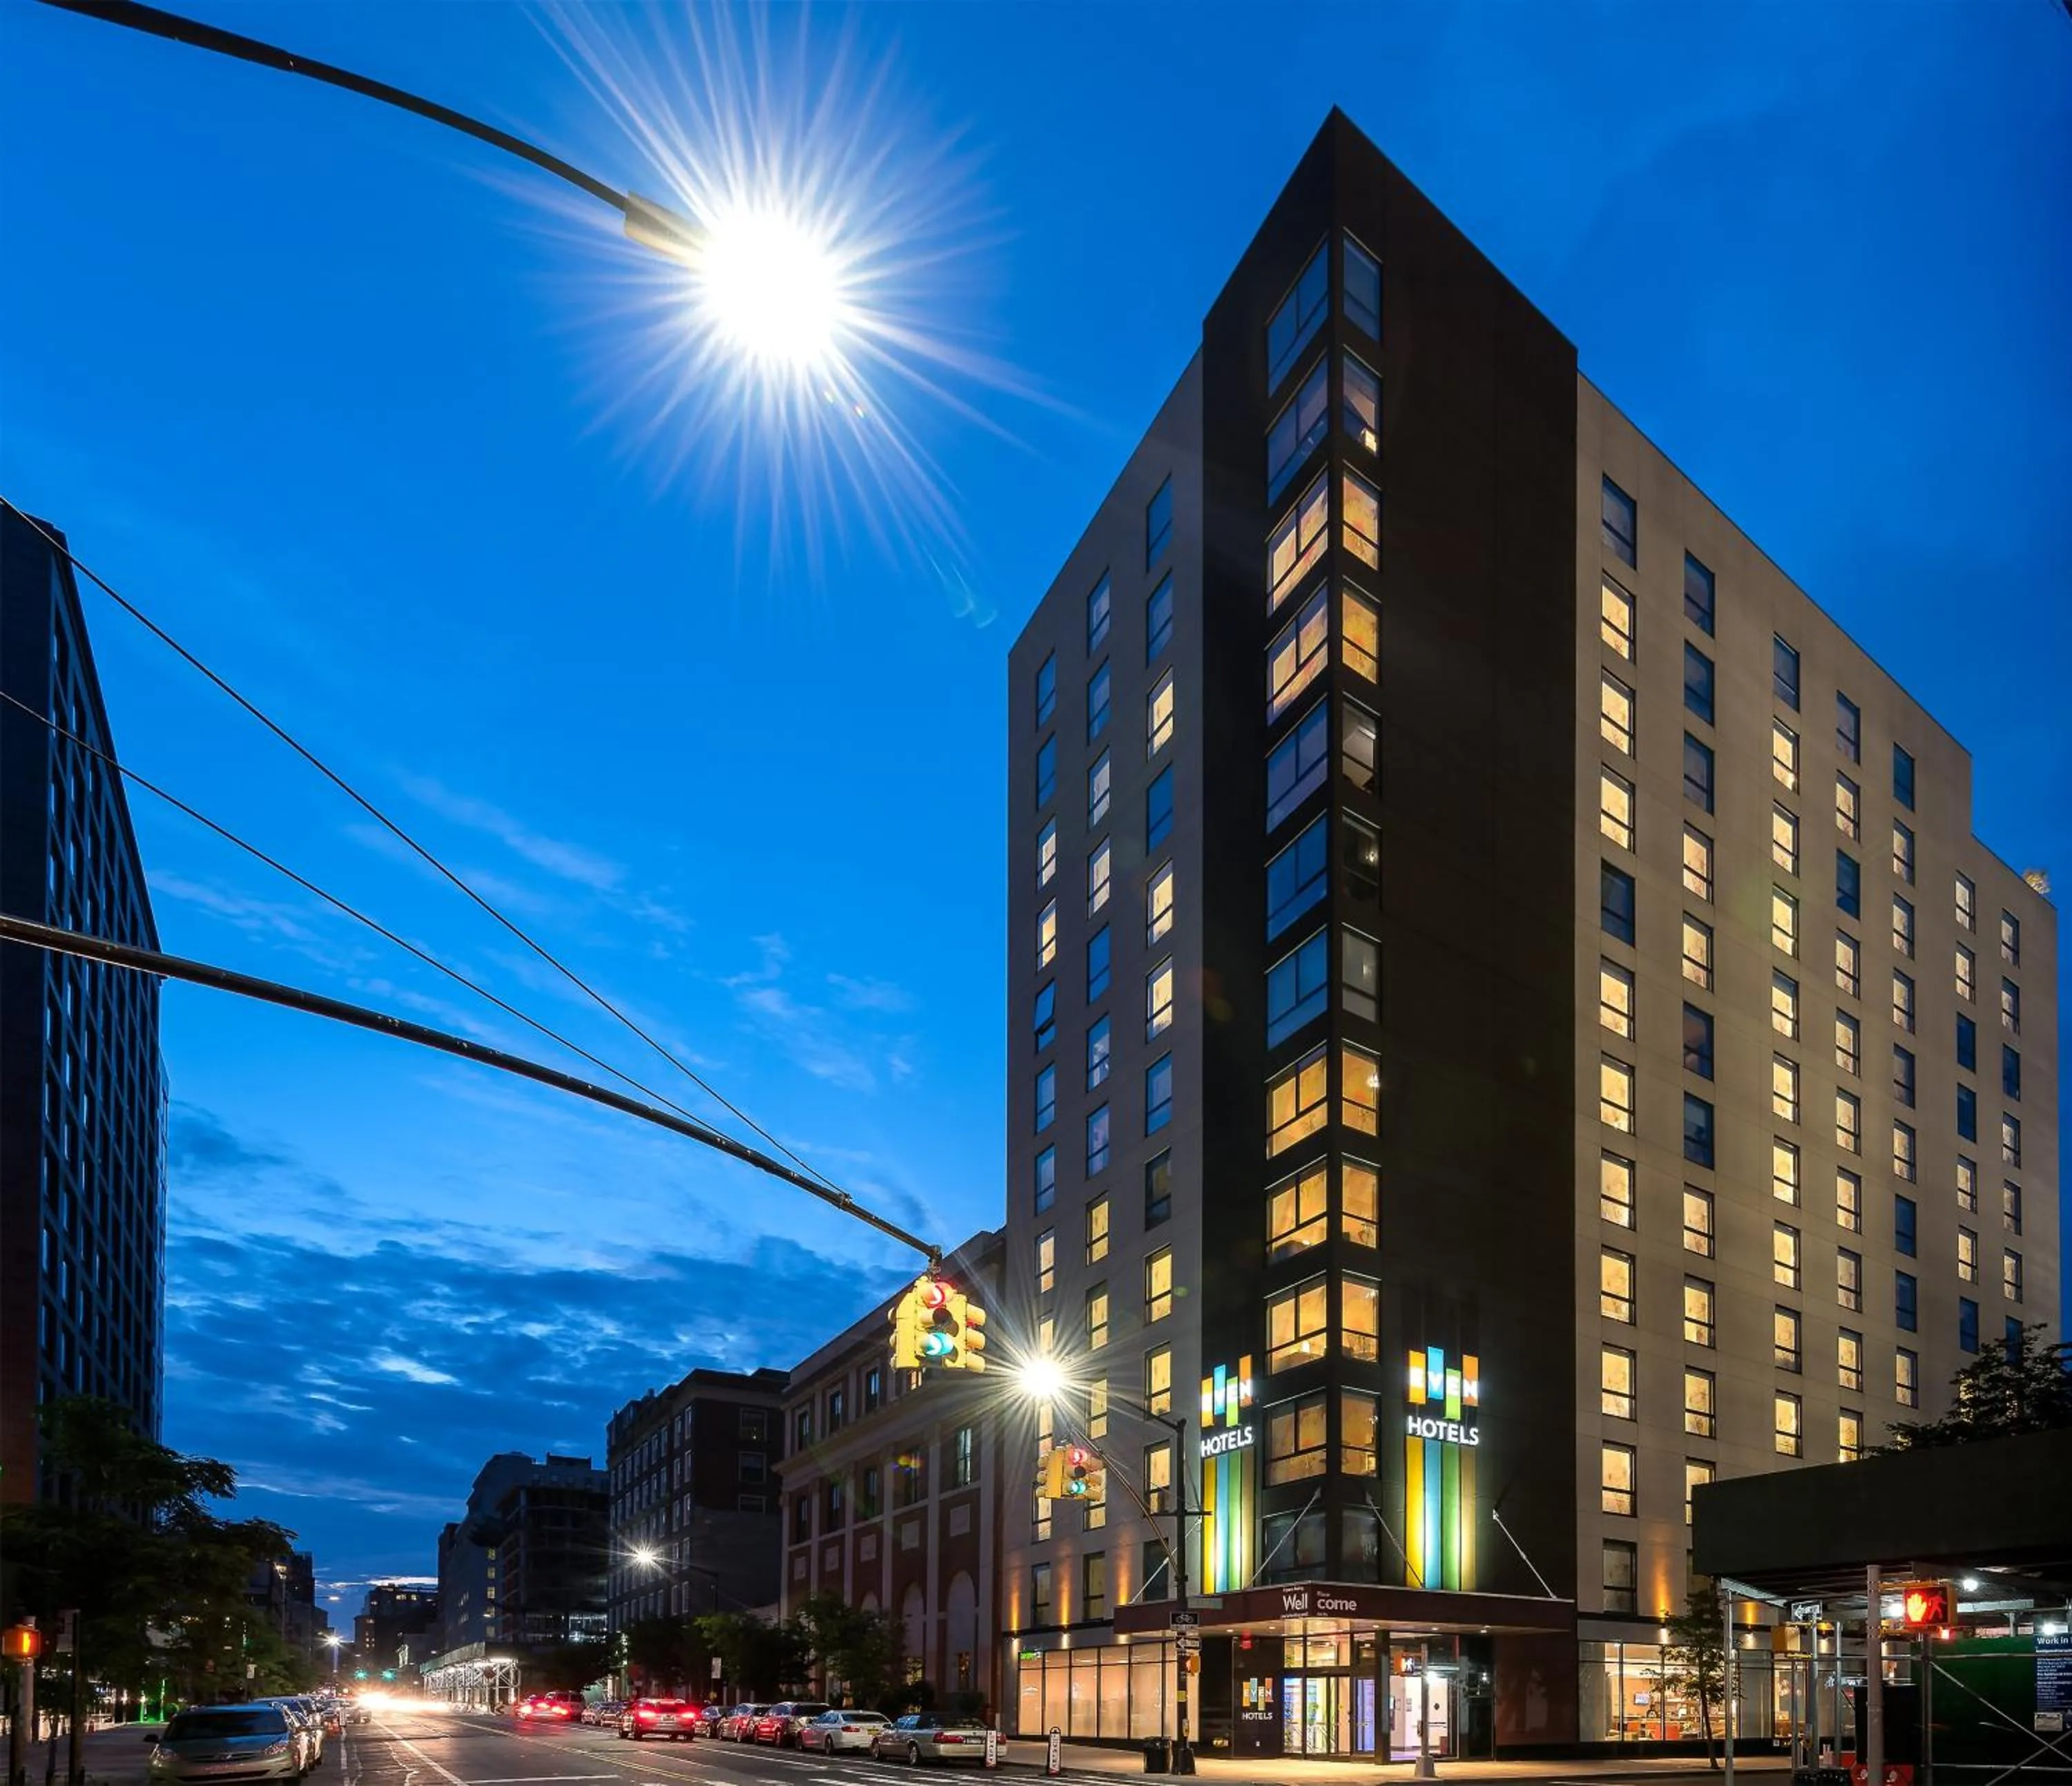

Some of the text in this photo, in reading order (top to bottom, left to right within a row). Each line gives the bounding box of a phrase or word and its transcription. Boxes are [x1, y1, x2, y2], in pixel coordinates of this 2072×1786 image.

[1202, 1379, 1254, 1413] EVEN
[1410, 1366, 1479, 1400] EVEN
[1200, 1426, 1254, 1457] HOTELS
[1408, 1415, 1479, 1446] HOTELS
[1283, 1593, 1308, 1611] Well
[1317, 1599, 1357, 1611] come
[1243, 1712, 1273, 1720] HOTELS
